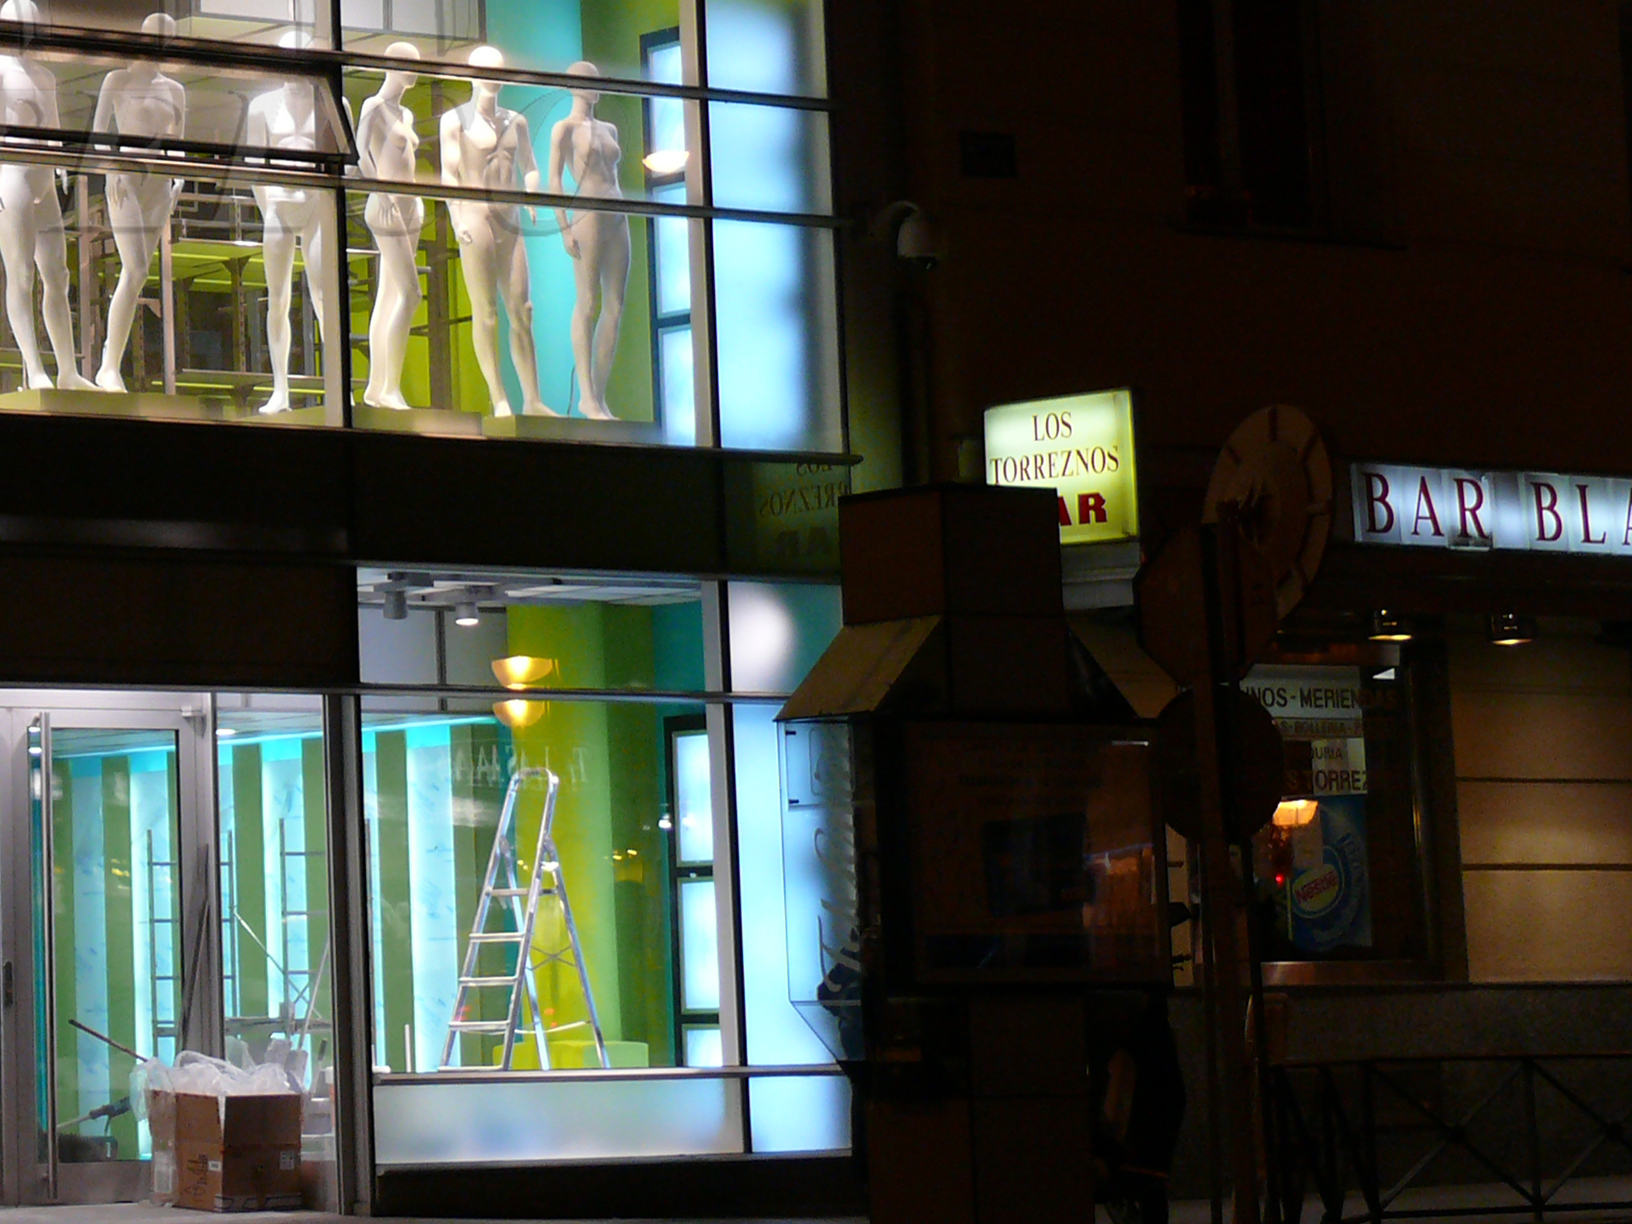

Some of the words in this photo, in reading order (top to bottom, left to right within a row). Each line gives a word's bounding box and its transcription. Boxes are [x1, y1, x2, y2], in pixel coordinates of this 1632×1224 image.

[1032, 411, 1073, 442] LOS
[989, 445, 1120, 486] TORREZNOS
[1364, 472, 1491, 540] BAR
